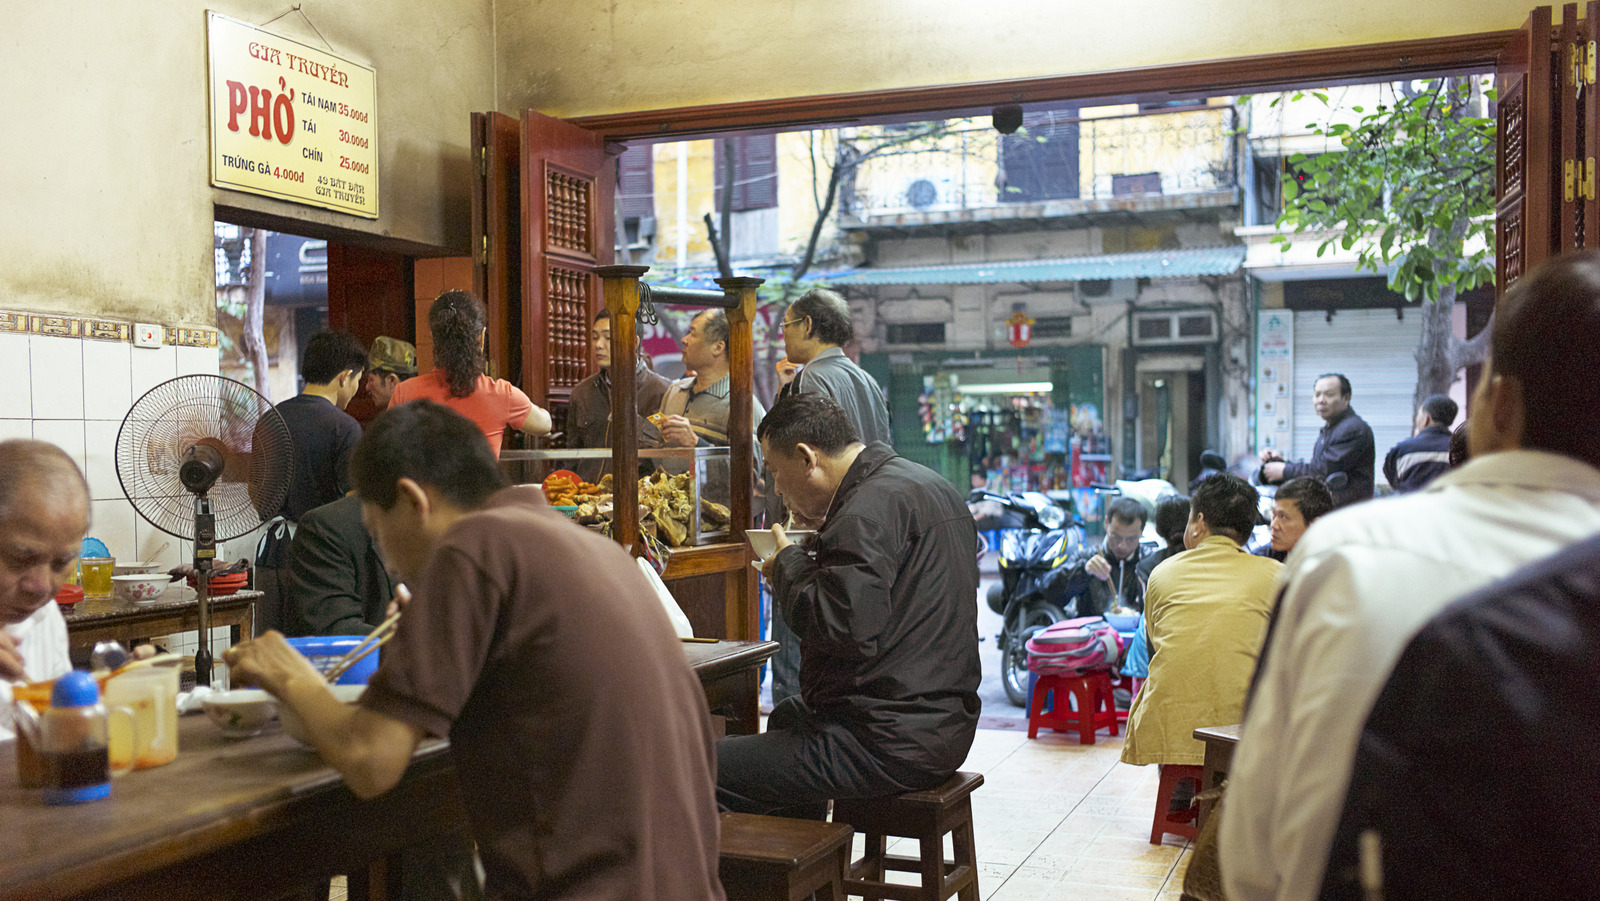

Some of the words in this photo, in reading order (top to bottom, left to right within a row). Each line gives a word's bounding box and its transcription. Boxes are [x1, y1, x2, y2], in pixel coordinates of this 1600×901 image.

[248, 41, 282, 66] GIA
[226, 75, 295, 145] PHỞ
[301, 92, 316, 107] TÁI
[317, 97, 337, 113] NẠM
[338, 102, 368, 124] 35.000đ
[302, 119, 317, 134] TÁI
[338, 129, 369, 149] 30.000đ
[221, 154, 256, 172] TRỨNG
[257, 161, 271, 176] GÀ
[273, 166, 305, 184] 4.000đ
[302, 147, 323, 163] CHÍN
[339, 155, 369, 175] 25.000đ
[315, 185, 332, 198] GIA
[317, 176, 329, 185] 49
